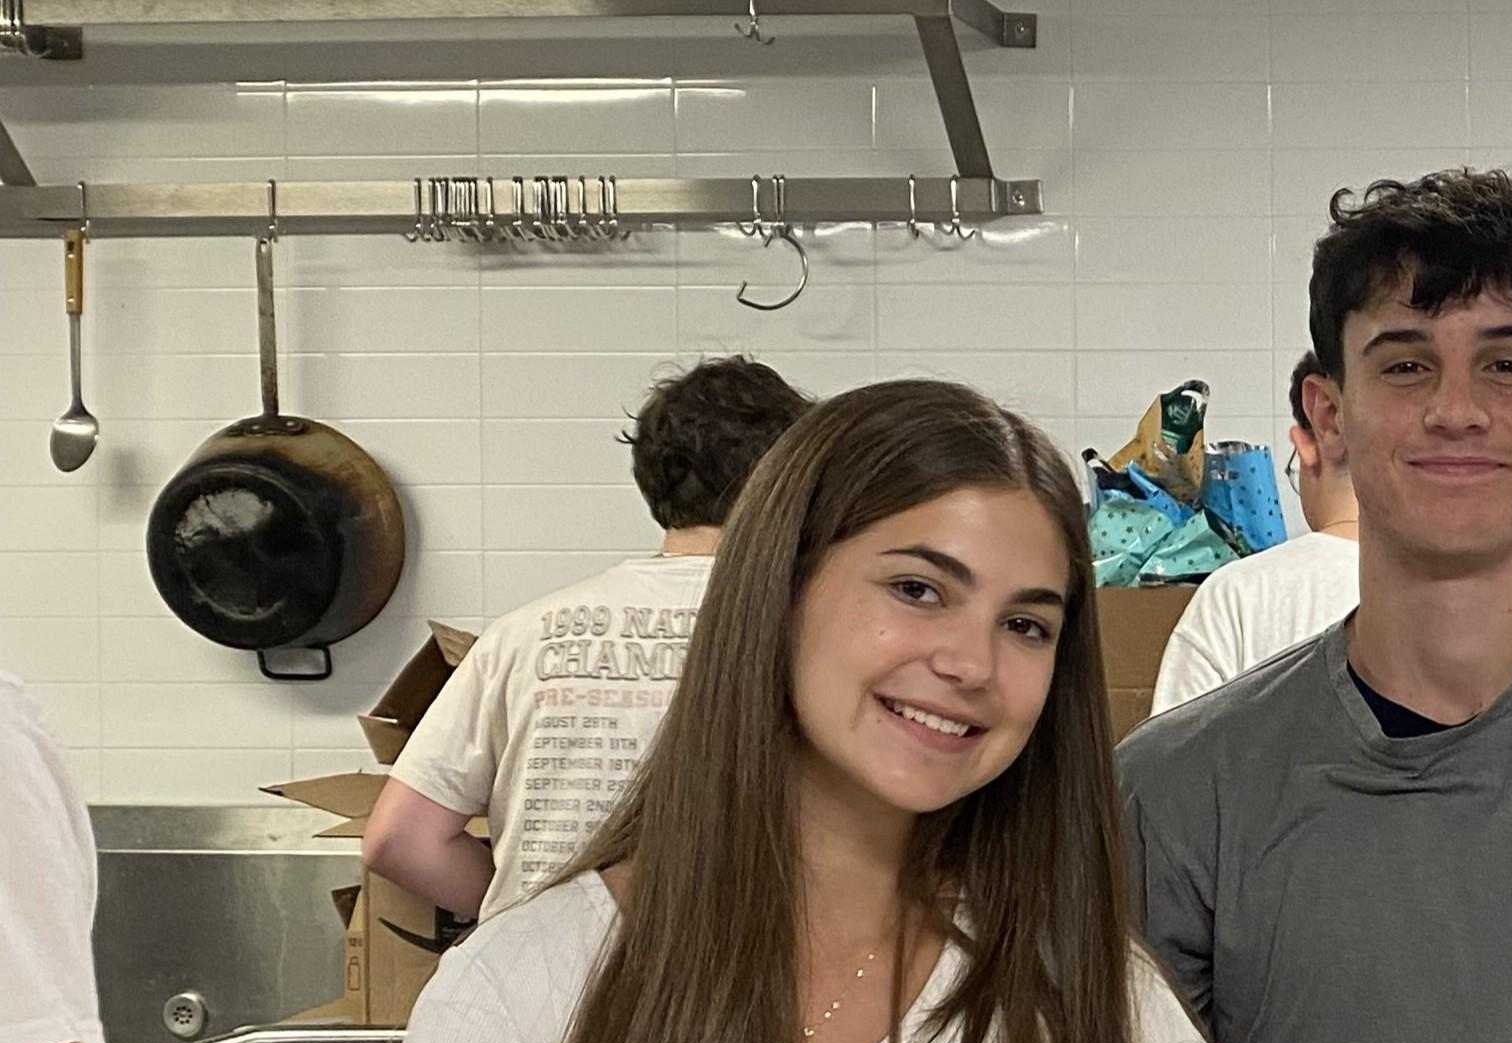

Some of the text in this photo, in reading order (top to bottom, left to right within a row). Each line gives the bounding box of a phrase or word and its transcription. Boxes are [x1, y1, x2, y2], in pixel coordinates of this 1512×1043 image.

[541, 605, 700, 640] 1999 NAT
[533, 687, 667, 708] PRE-SEASO
[533, 736, 603, 750] EPTEMBER
[527, 757, 603, 771] SEPTEMBER
[525, 777, 602, 791] SEPTEMBER
[523, 799, 580, 813] OCTOBER
[522, 819, 579, 833] OCTOBER
